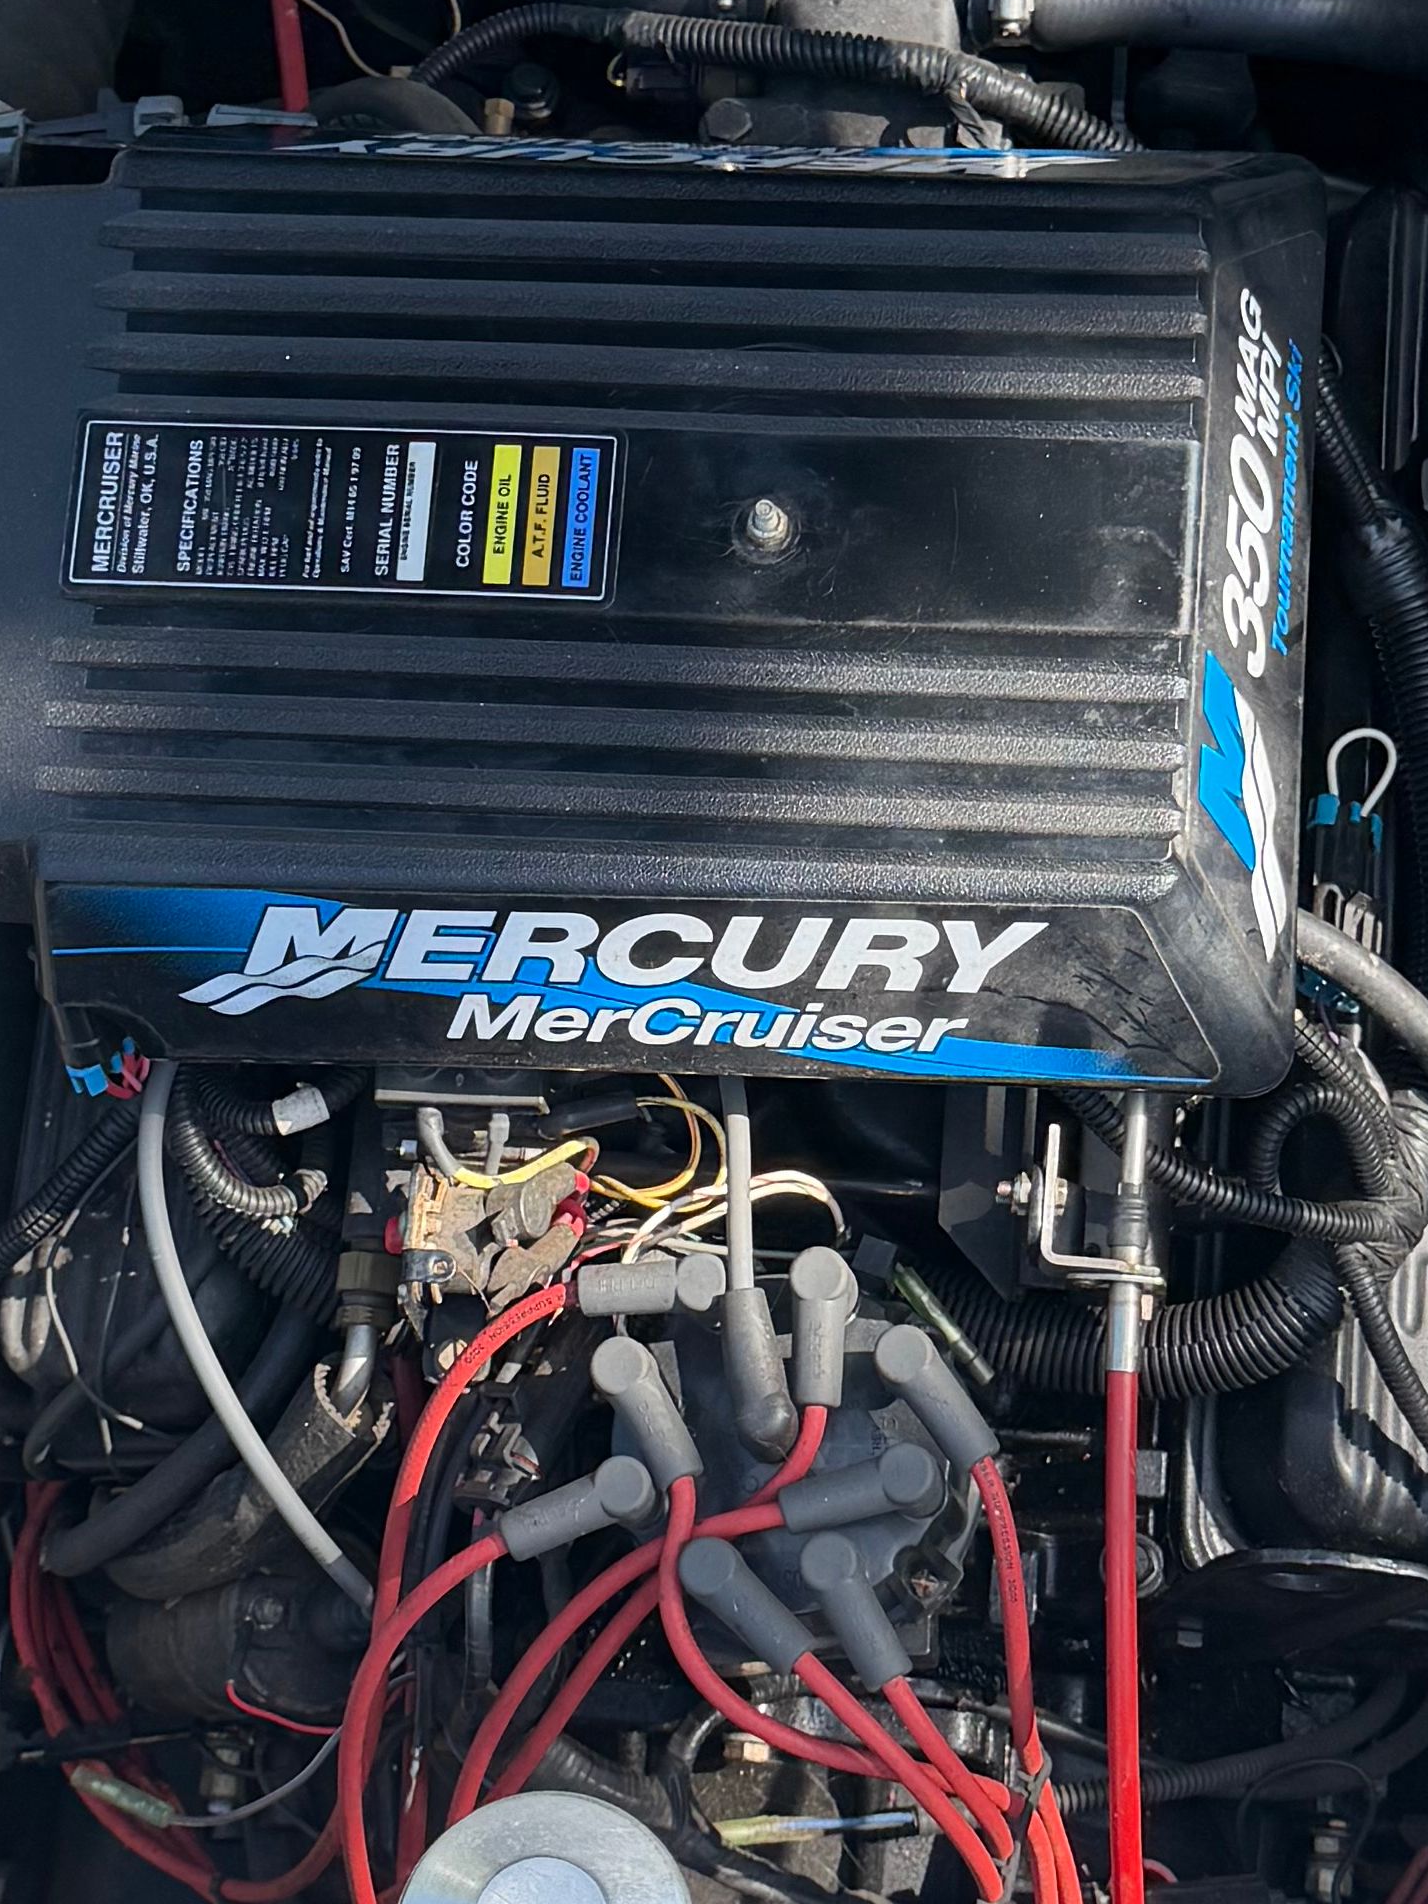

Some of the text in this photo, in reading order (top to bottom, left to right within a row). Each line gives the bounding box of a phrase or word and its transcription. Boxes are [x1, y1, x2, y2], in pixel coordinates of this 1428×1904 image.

[1256, 330, 1282, 458] MPI
[89, 431, 125, 571] MERCRUISER
[115, 433, 142, 572] Division of Mercury Marine
[130, 433, 159, 573] Stillwater, OK, U.S.A.
[175, 439, 205, 571] SPECIFICATIONS
[374, 444, 400, 575] SERIAL NUMBER
[455, 459, 478, 567] COLOR CODE
[492, 473, 511, 554] ENGINE OIL
[531, 473, 550, 557] A.T.F. FLUID
[569, 453, 592, 581] ENGINE COOLANT
[1222, 287, 1274, 679] 350 MAG
[1270, 336, 1304, 657] Tournament Ski
[339, 550, 351, 572] SAV
[178, 904, 1050, 1016] MERCURY
[445, 990, 970, 1055] MerCruiser
